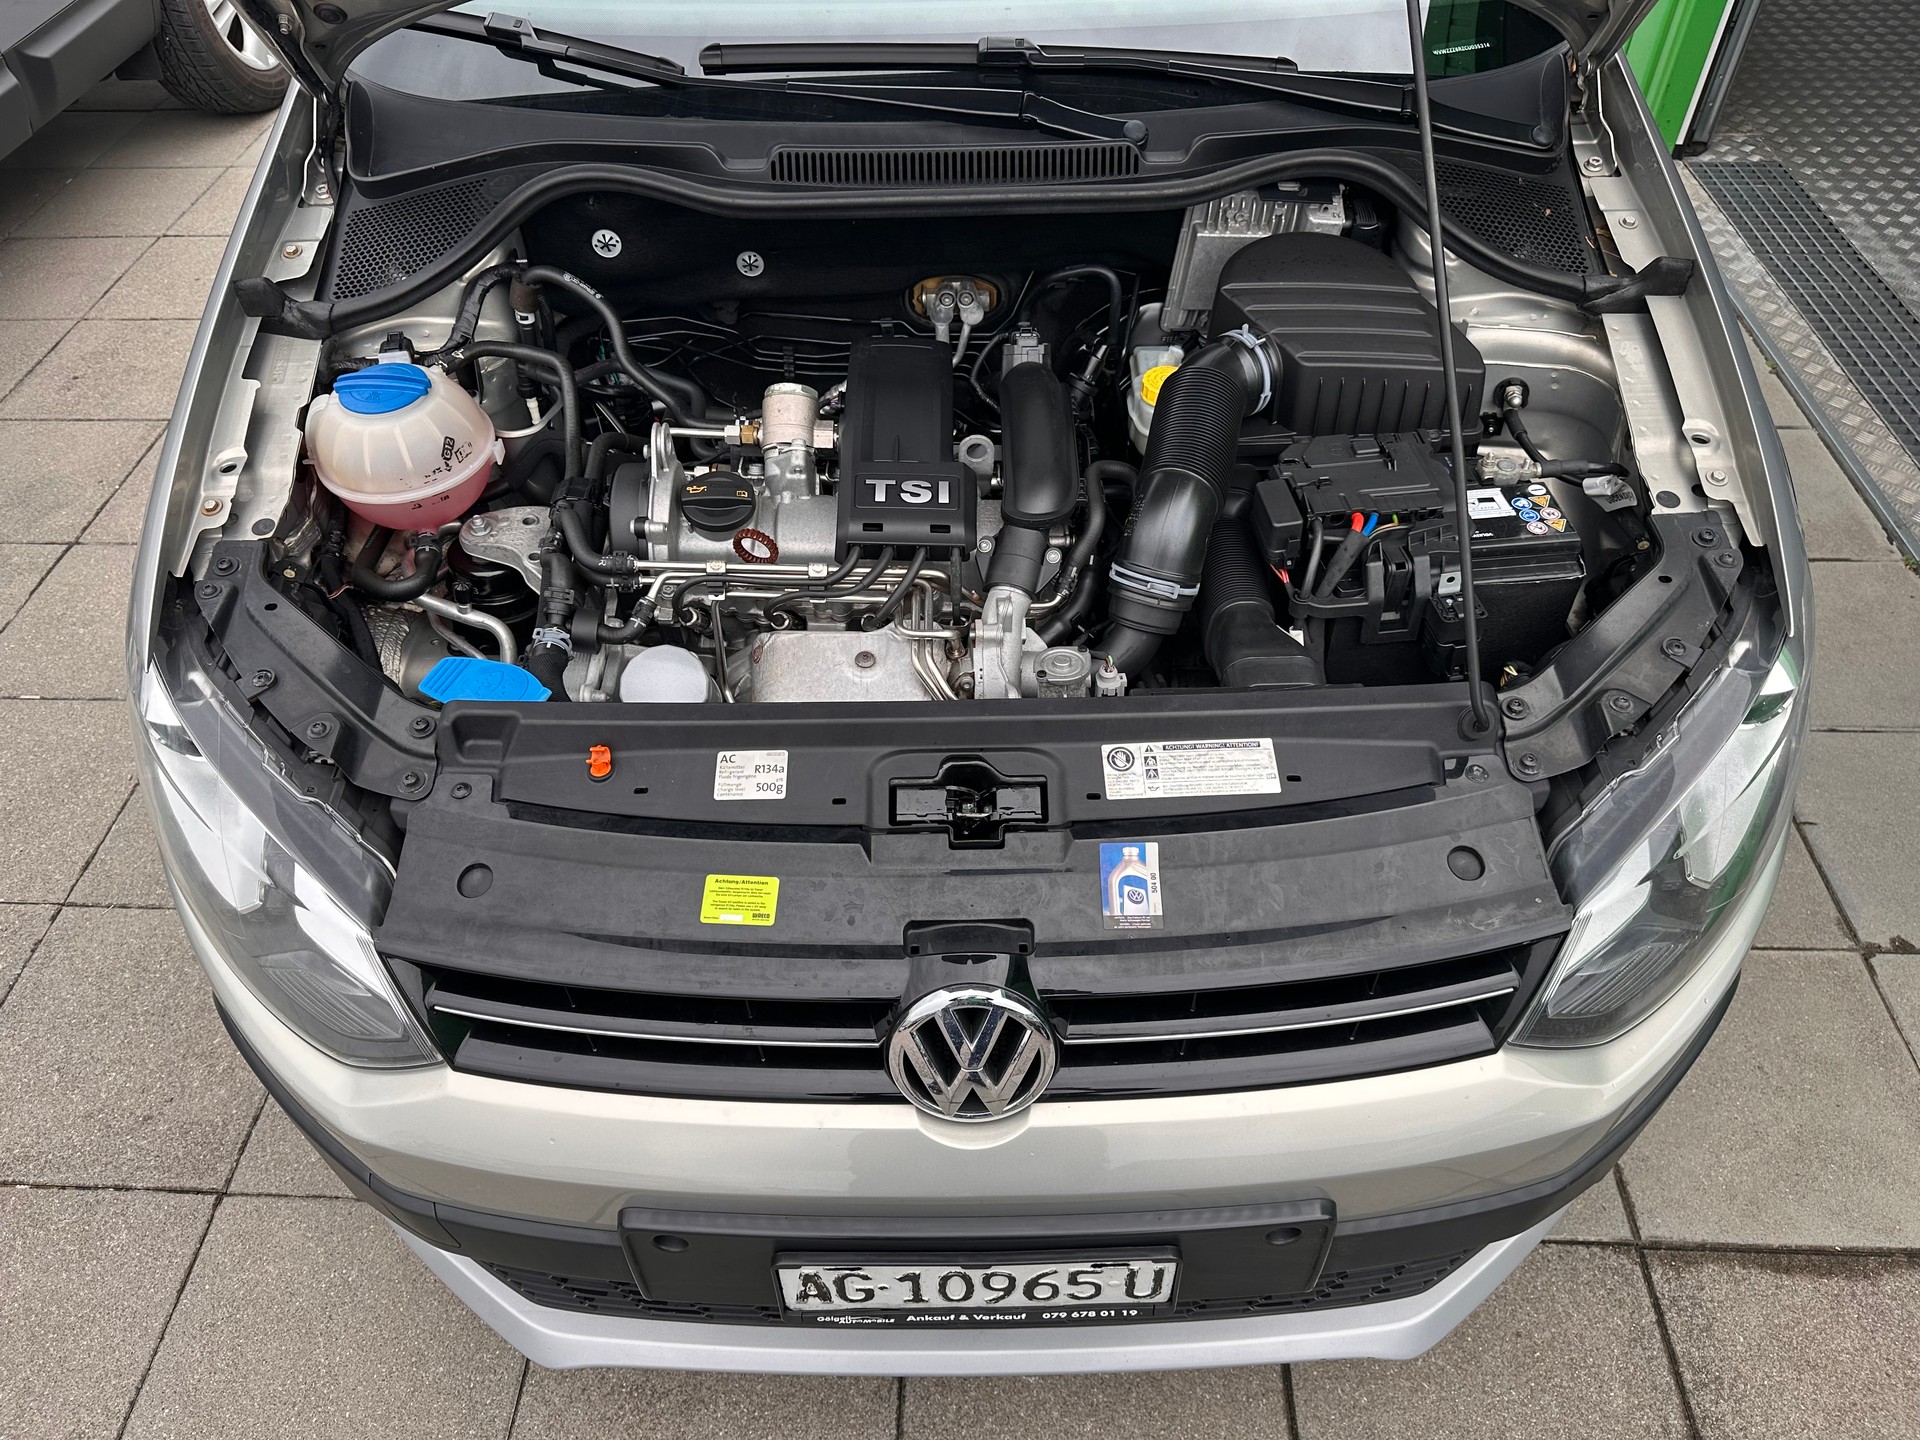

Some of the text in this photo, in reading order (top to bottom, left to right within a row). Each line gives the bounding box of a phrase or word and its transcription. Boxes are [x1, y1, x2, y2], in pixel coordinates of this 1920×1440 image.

[443, 438, 454, 459] G12
[865, 479, 949, 503] TSI
[720, 754, 736, 763] AC
[754, 764, 784, 774] R134a
[756, 782, 783, 795] 500g
[714, 878, 769, 886] Achtung/Attention
[892, 1000, 1051, 1120] VW
[1124, 1266, 1165, 1300] U
[906, 1314, 955, 1322] Ankauf
[972, 1313, 1027, 1321] Verkauf
[1070, 1310, 1096, 1318] 678
[1121, 1309, 1138, 1317] 19
